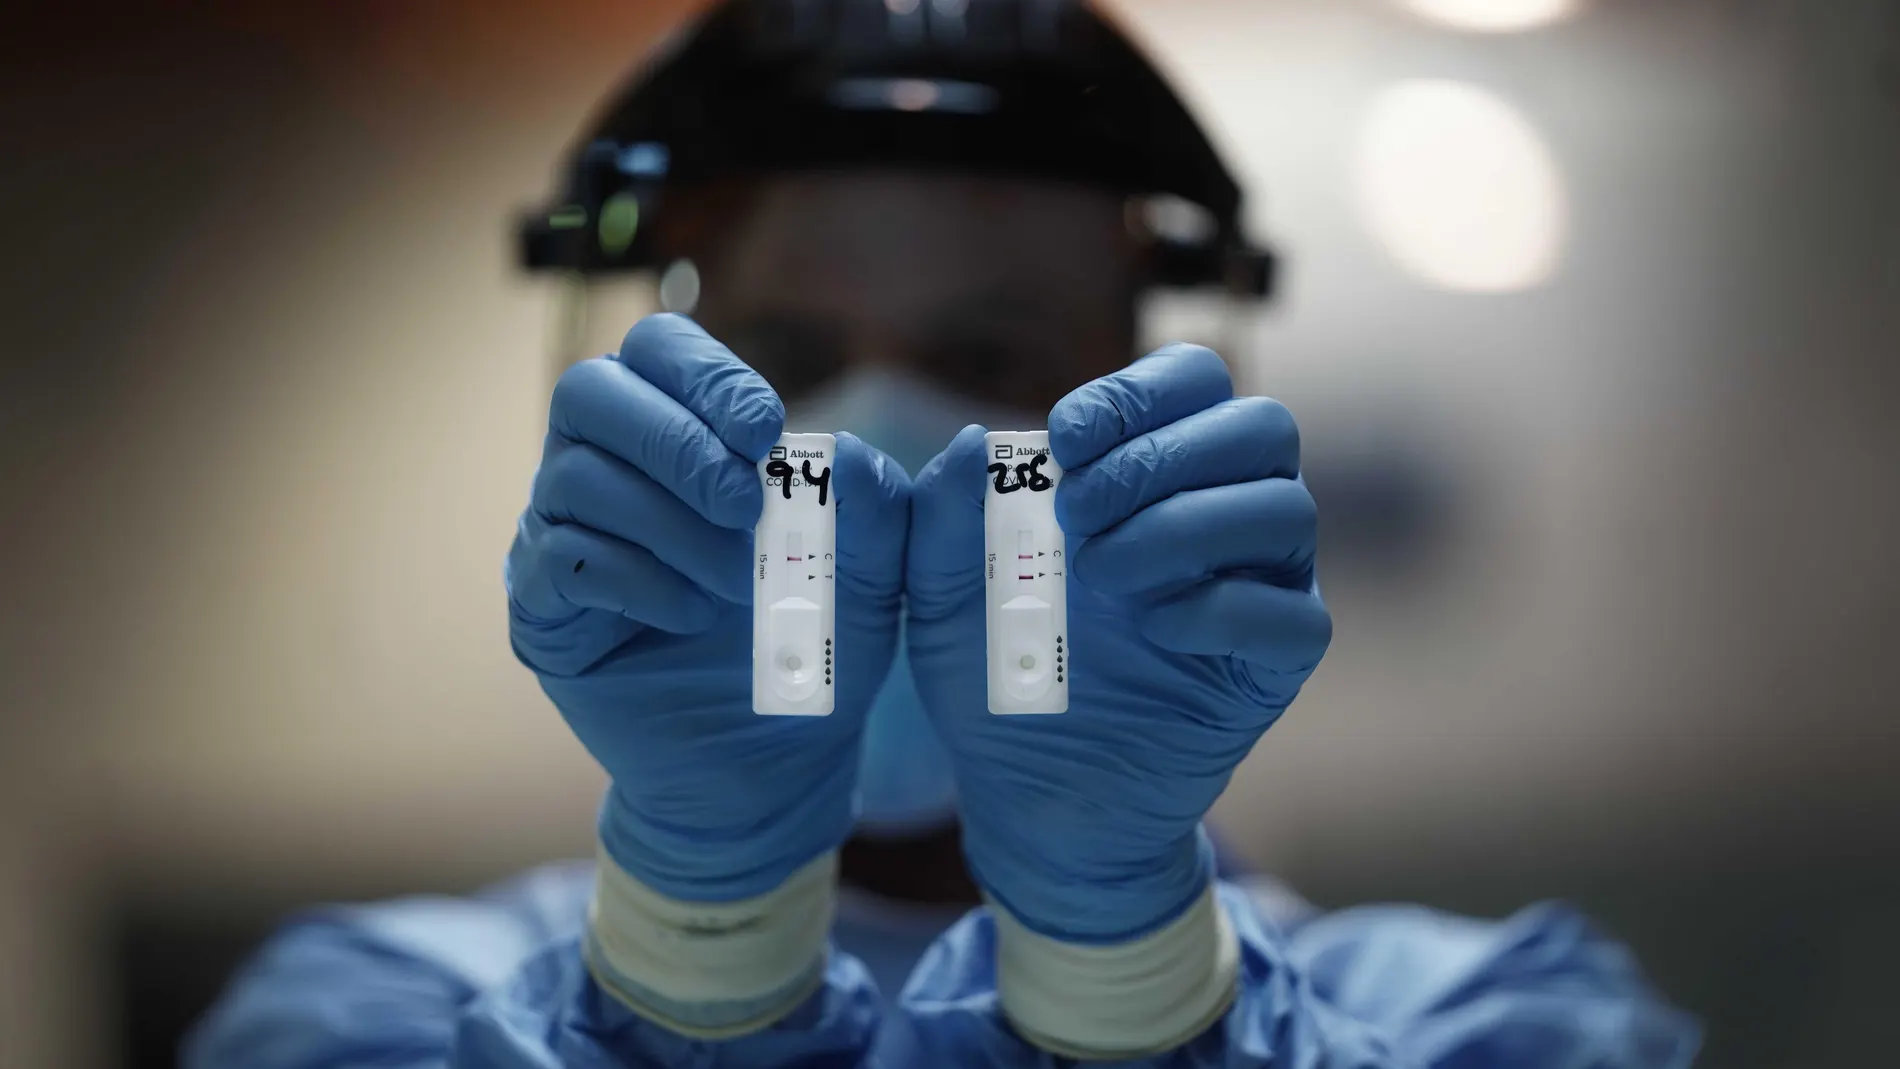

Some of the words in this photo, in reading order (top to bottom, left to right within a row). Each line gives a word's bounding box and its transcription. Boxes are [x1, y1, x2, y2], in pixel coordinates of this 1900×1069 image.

[790, 450, 824, 458] Abbott
[1016, 447, 1051, 456] Abbott
[766, 460, 831, 506] 94
[760, 554, 767, 563] 15
[988, 553, 996, 562] 15
[988, 564, 996, 579] min
